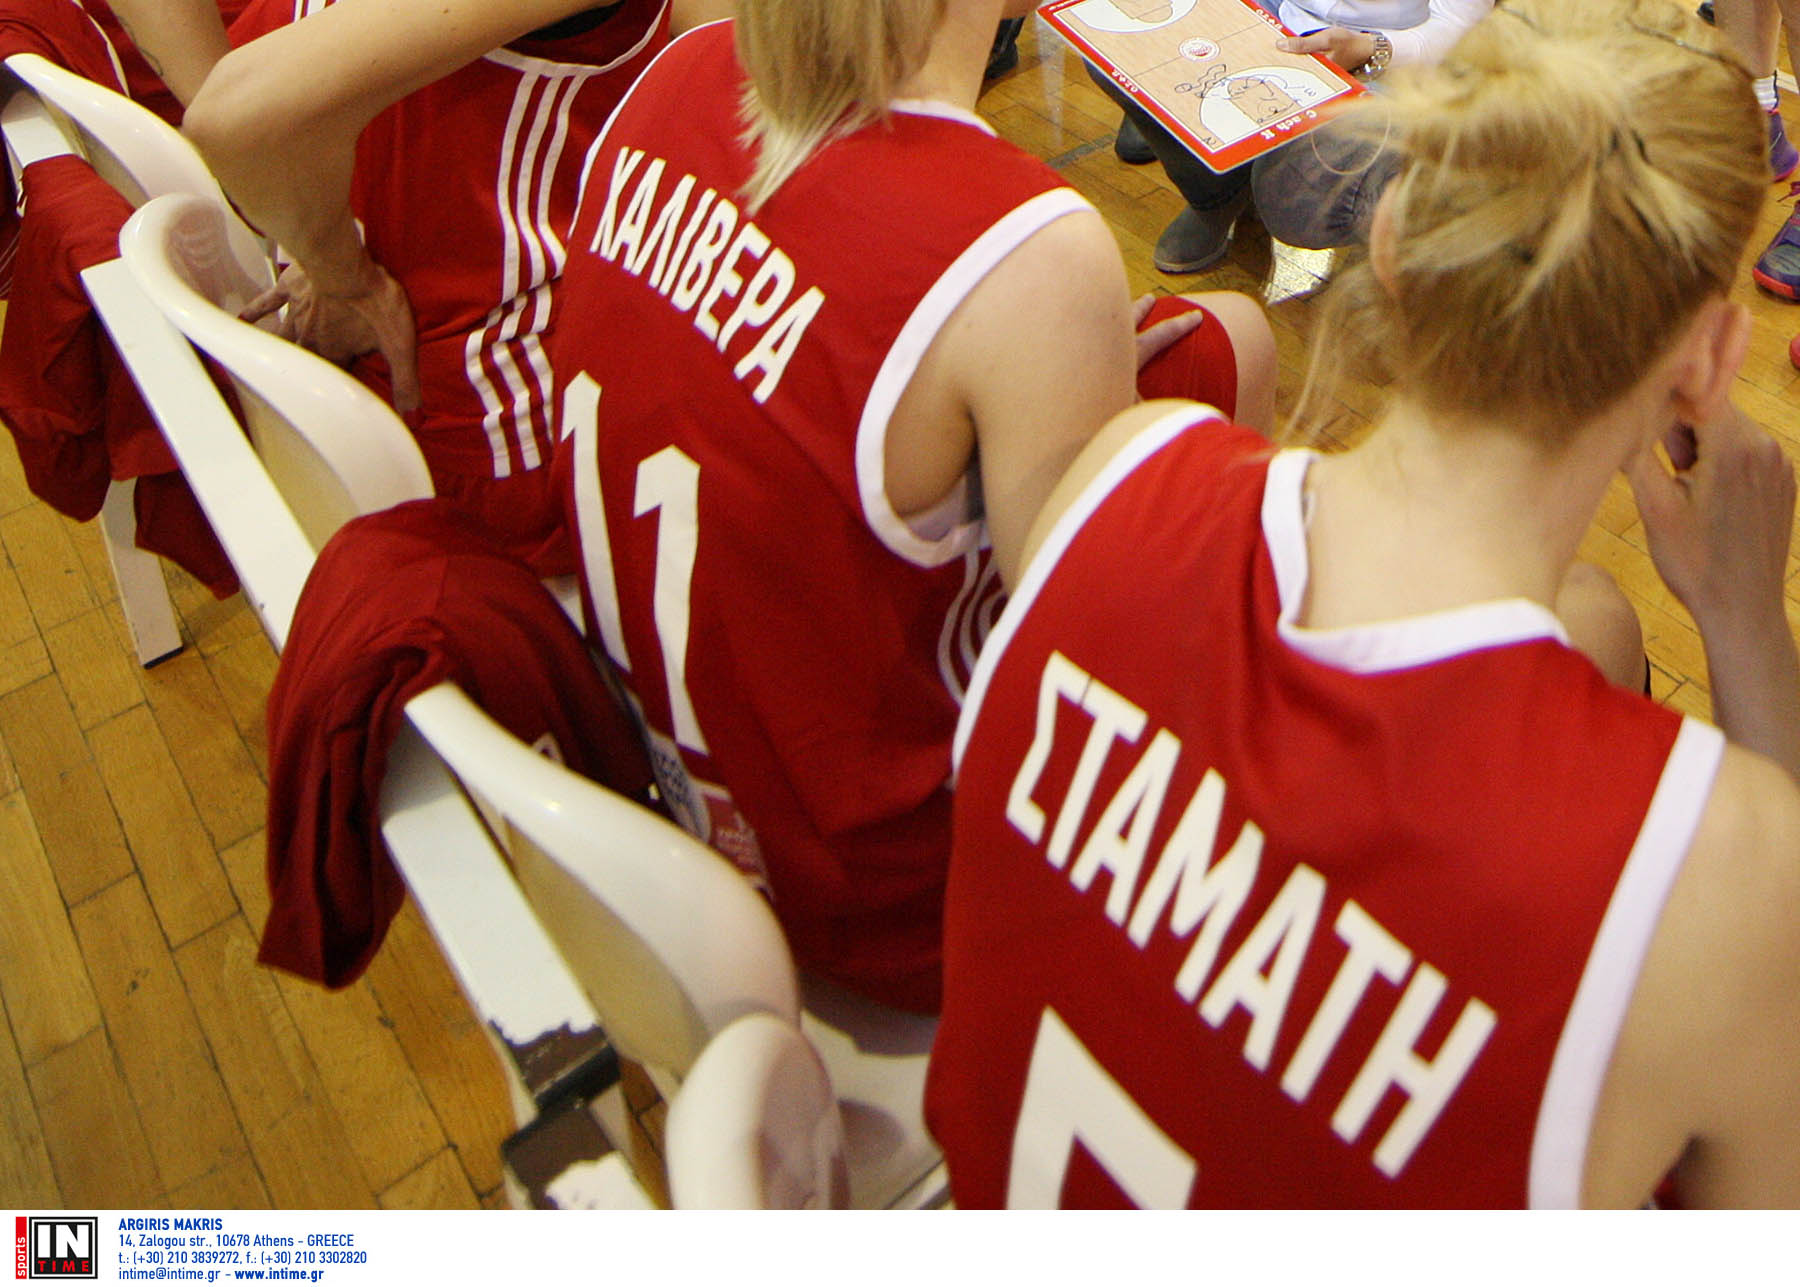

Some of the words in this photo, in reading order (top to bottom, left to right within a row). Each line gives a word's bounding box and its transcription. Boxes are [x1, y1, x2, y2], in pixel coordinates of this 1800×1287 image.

[589, 146, 826, 405] ΧΑΛΙΒΕΡΑ
[561, 369, 711, 756] 11
[1006, 650, 1498, 1180] ΣΤΑΜΑΤΗ
